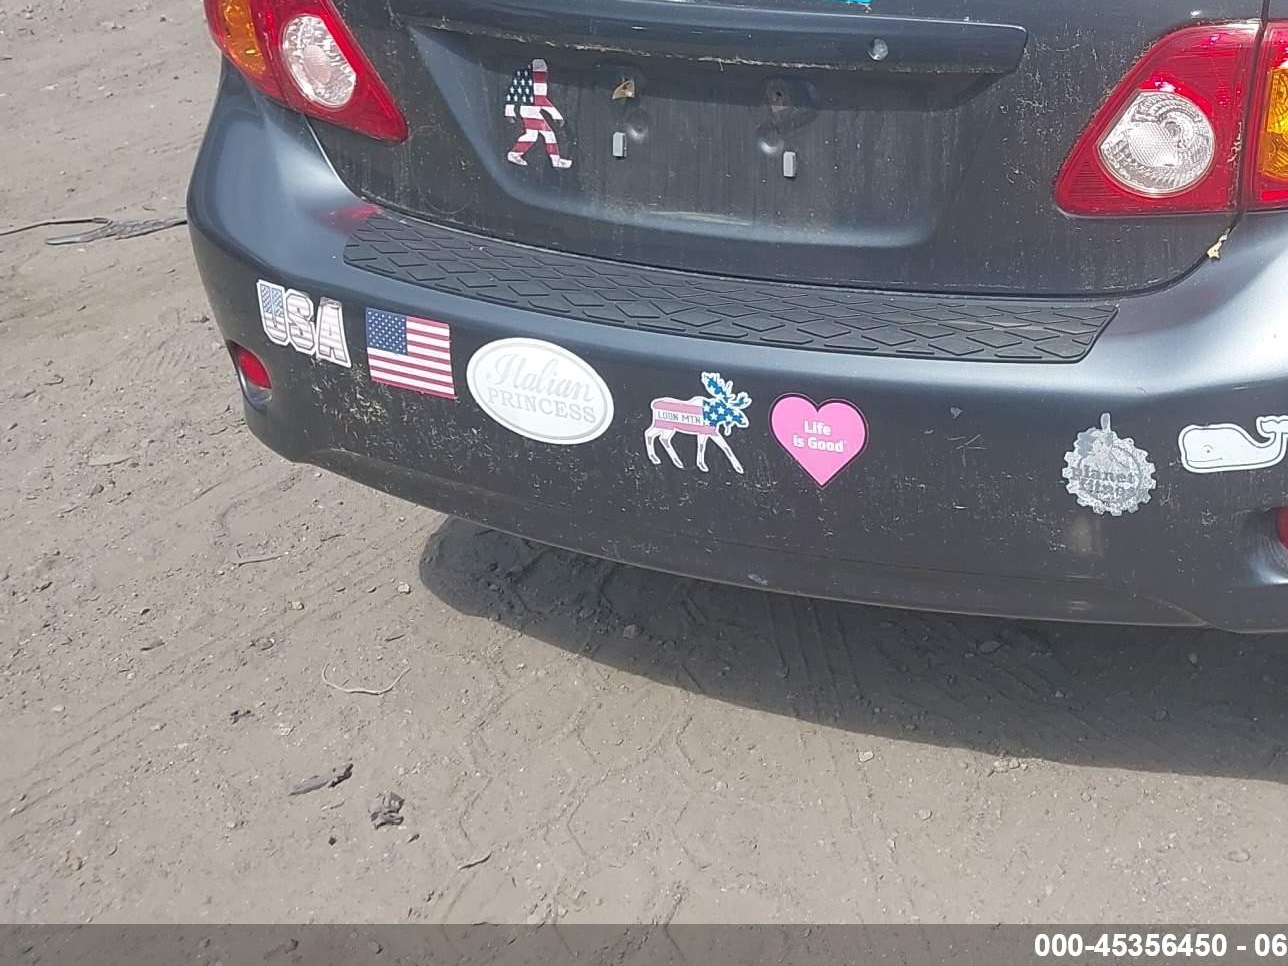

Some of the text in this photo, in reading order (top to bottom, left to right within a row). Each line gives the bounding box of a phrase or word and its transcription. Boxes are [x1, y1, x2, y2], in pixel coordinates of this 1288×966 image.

[256, 279, 352, 368] USA
[483, 353, 593, 402] Italian
[487, 387, 597, 424] PRINCESS
[657, 411, 679, 421] LOON
[804, 420, 831, 436] Life
[793, 435, 844, 452] is Good
